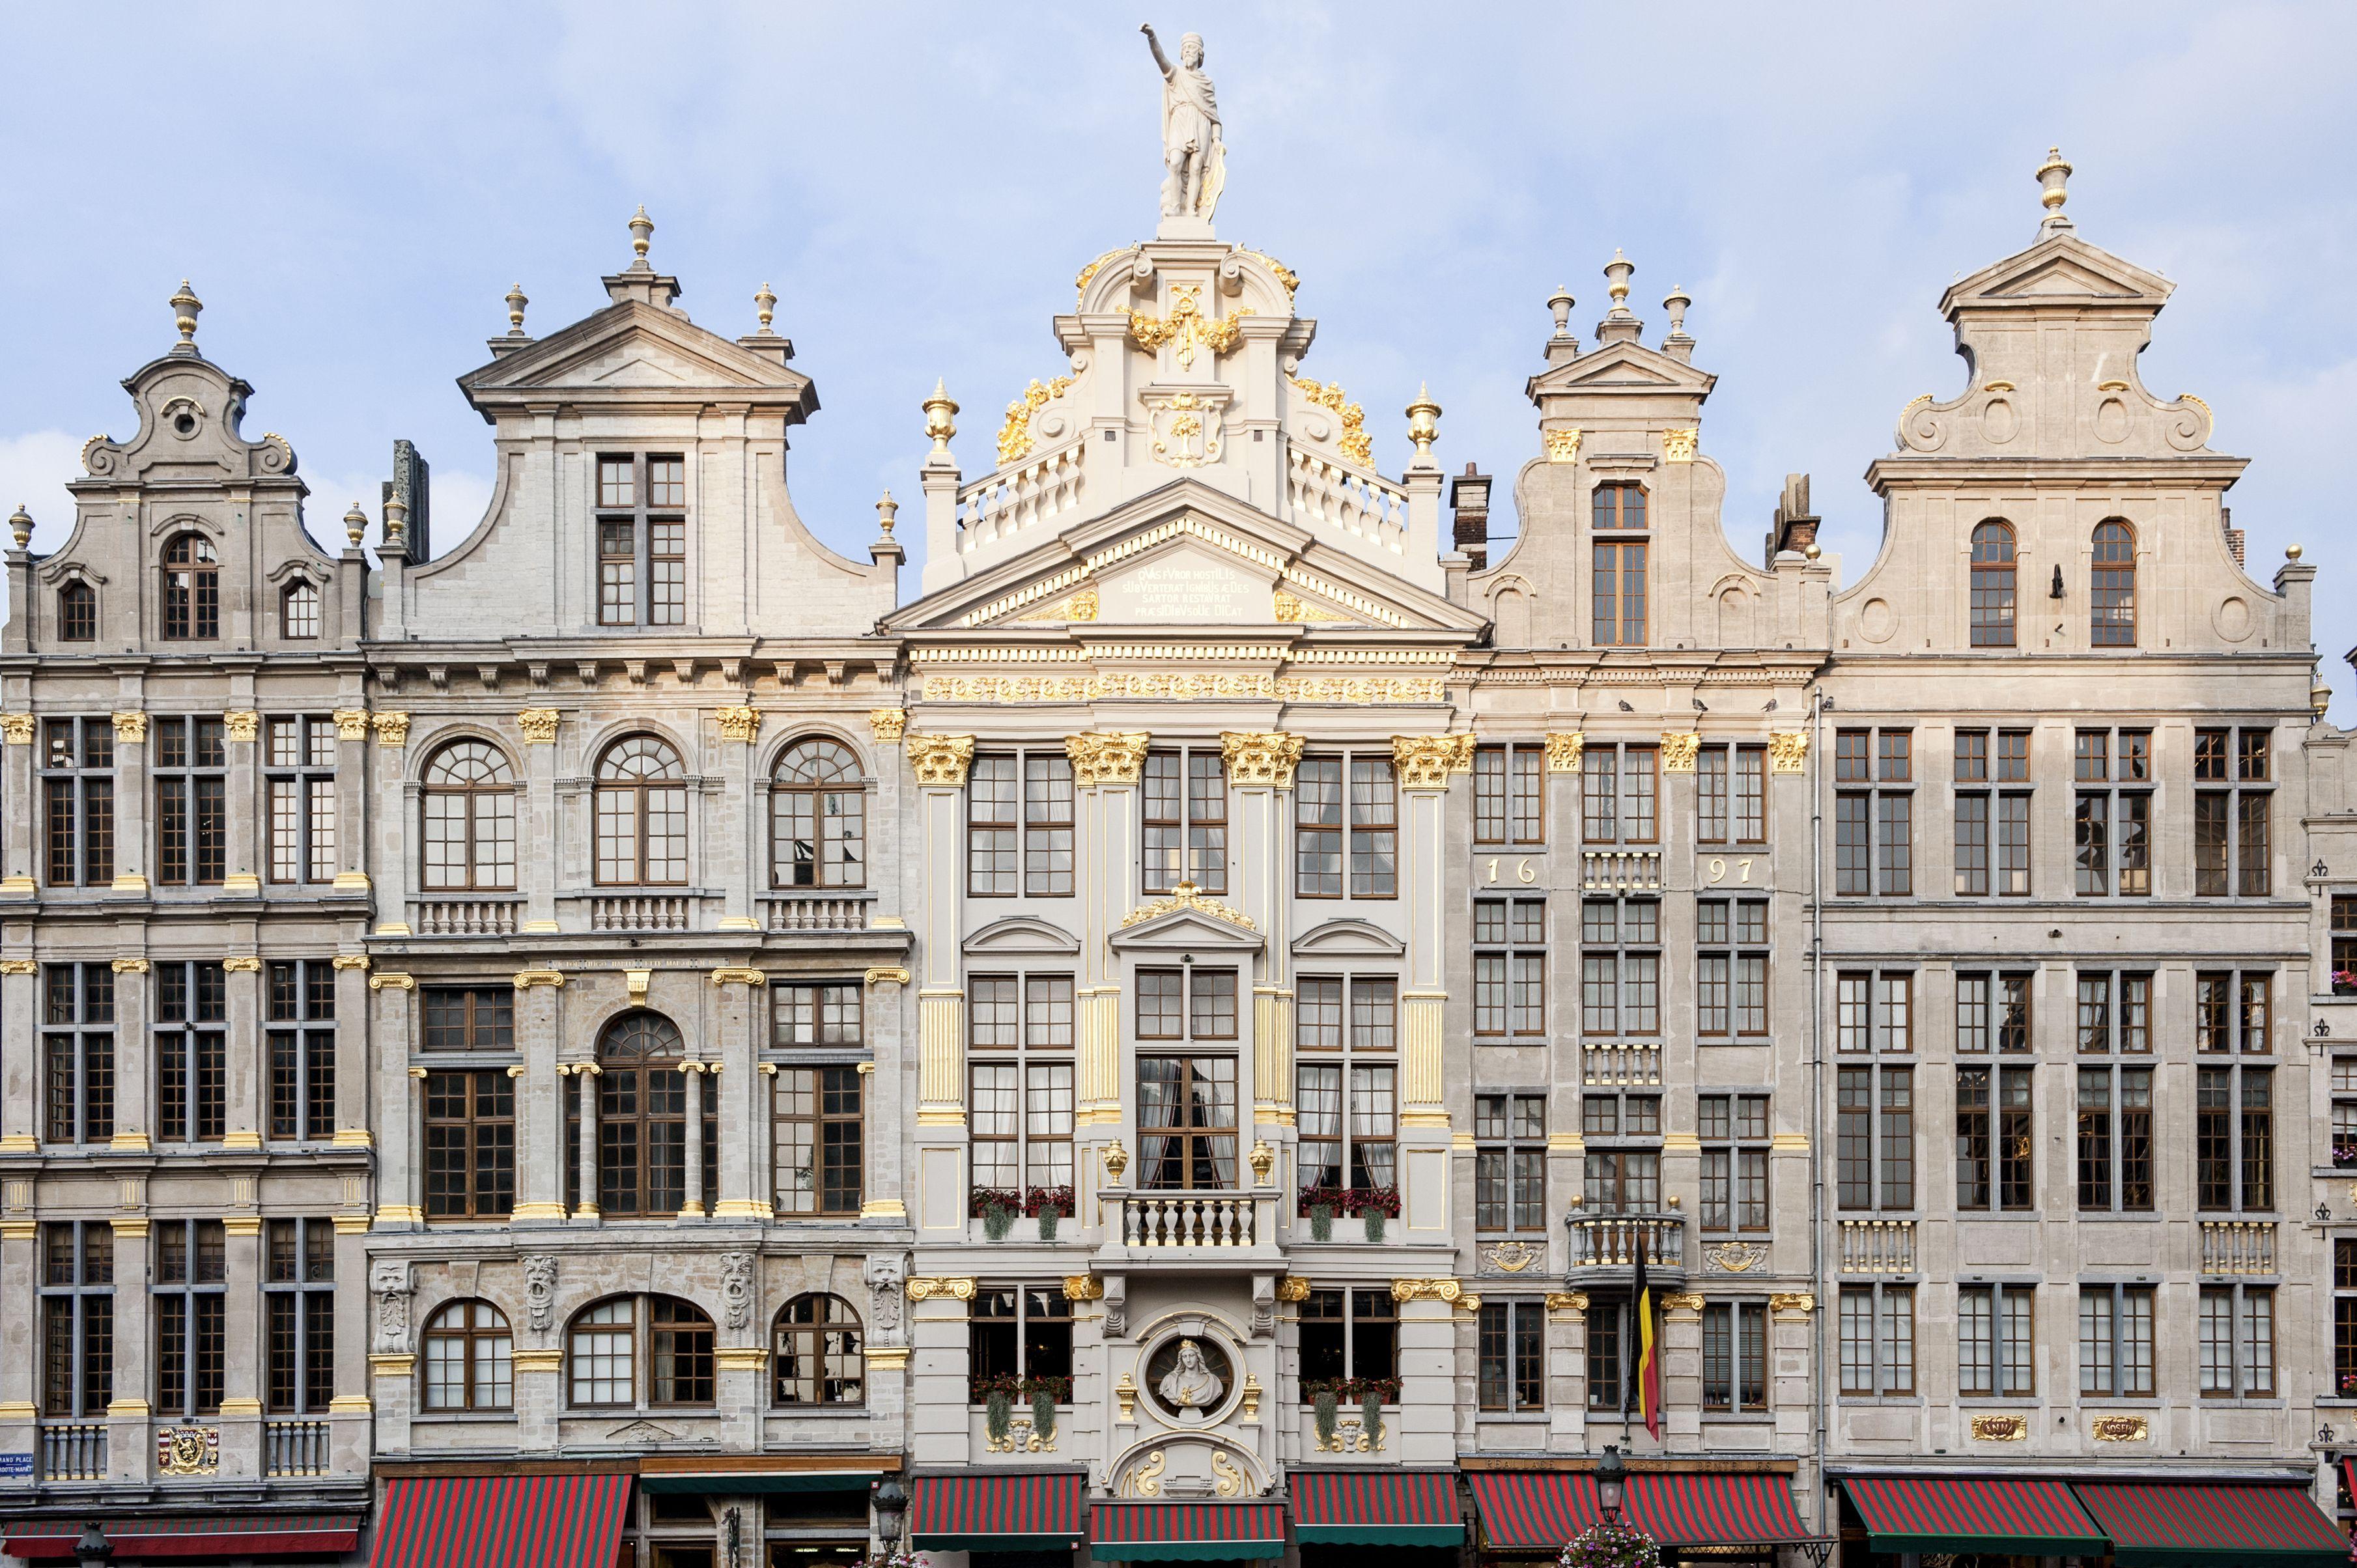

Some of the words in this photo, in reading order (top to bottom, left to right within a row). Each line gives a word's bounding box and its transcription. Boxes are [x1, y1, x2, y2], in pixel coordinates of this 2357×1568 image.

[1163, 568, 1191, 580] FVROR
[1193, 568, 1235, 580] HOSTILIS
[1142, 595, 1179, 603] SARTOR
[1183, 593, 1232, 603] RESTAVRAT
[1215, 605, 1243, 617] DICAT
[2106, 1423, 2136, 1435] JOSEPH
[1597, 1460, 1672, 1471] BRECHT
[1695, 1461, 1772, 1472] DENTELLES
